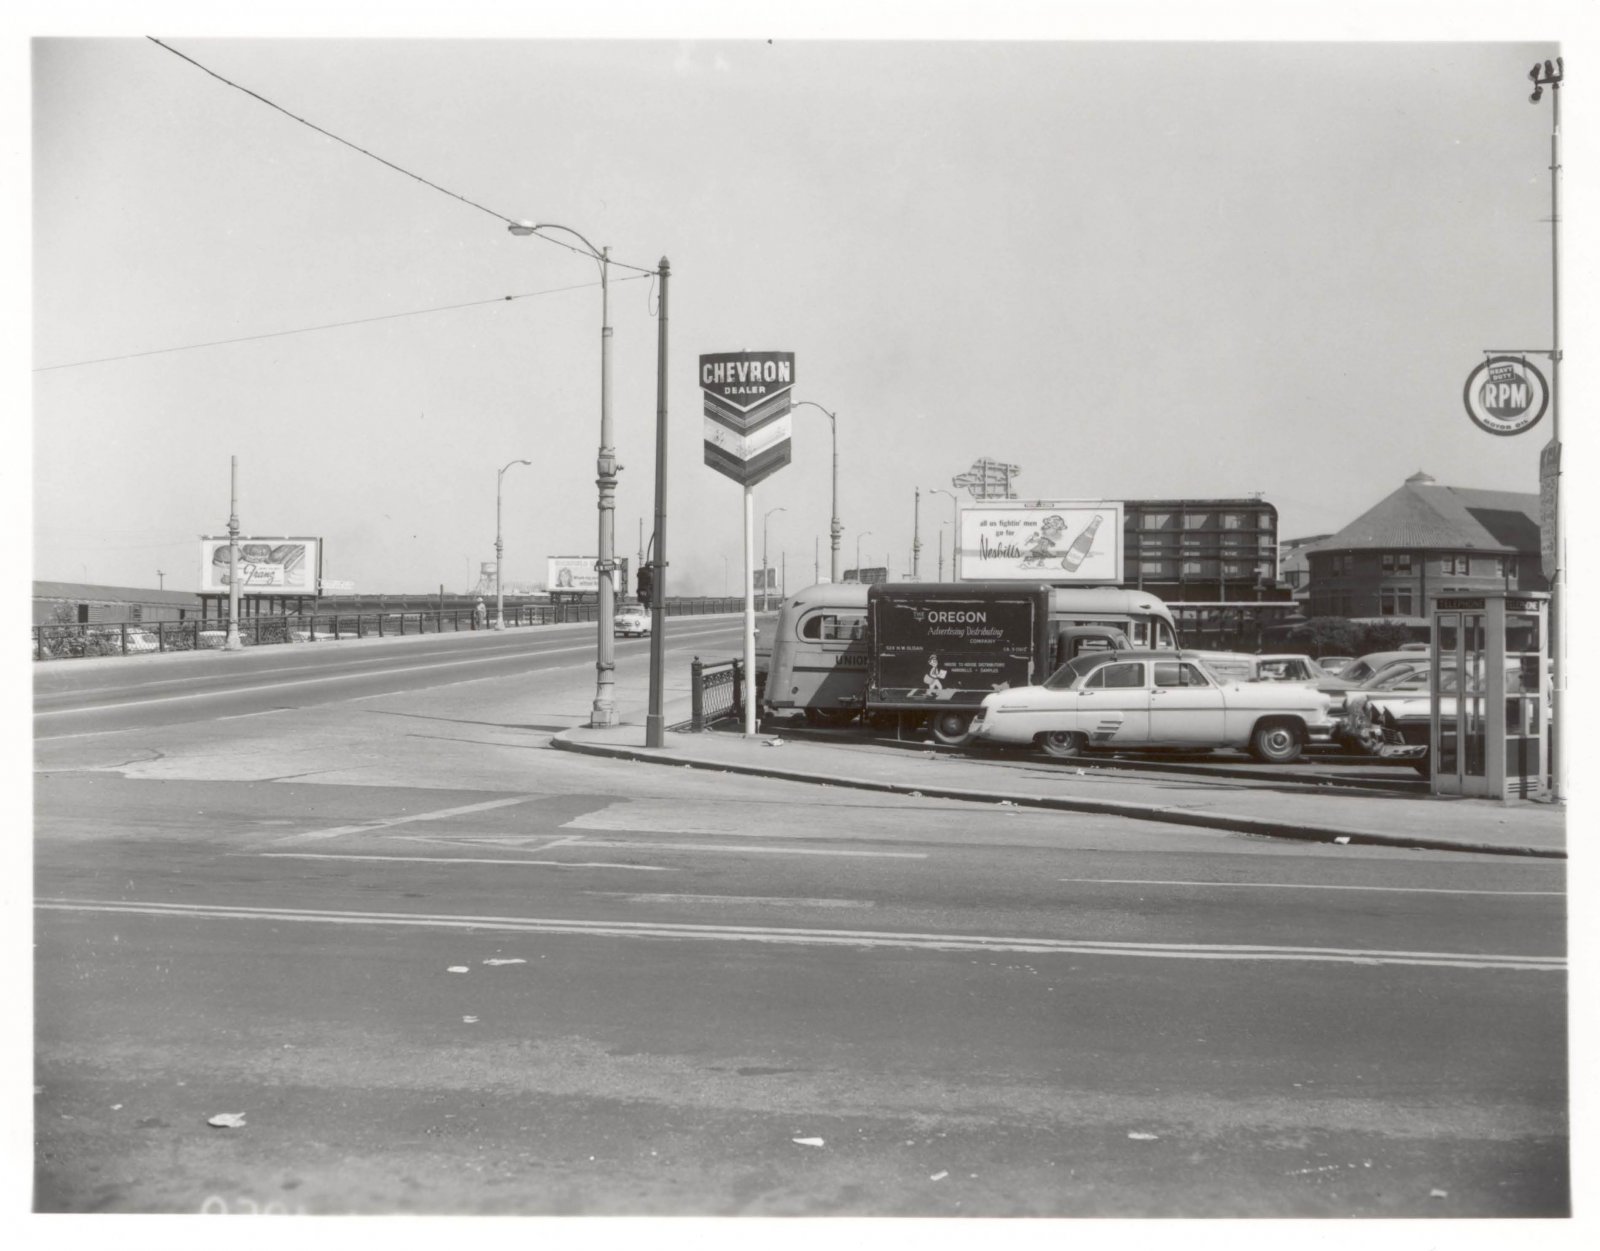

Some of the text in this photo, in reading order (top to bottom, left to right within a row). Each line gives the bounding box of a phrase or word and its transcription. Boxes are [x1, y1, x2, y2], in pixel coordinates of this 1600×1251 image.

[702, 360, 791, 384] CHEVRON
[1489, 366, 1513, 376] HEAVY
[1492, 372, 1512, 381] DUTY
[724, 385, 767, 395] DEALER
[1484, 383, 1527, 409] RPM
[1482, 418, 1529, 430] MOTOR OIL
[980, 519, 988, 527] all
[1439, 600, 1485, 609] TELEPHONE
[927, 611, 987, 623] OREGON
[927, 626, 1004, 639] Advertising Distributing
